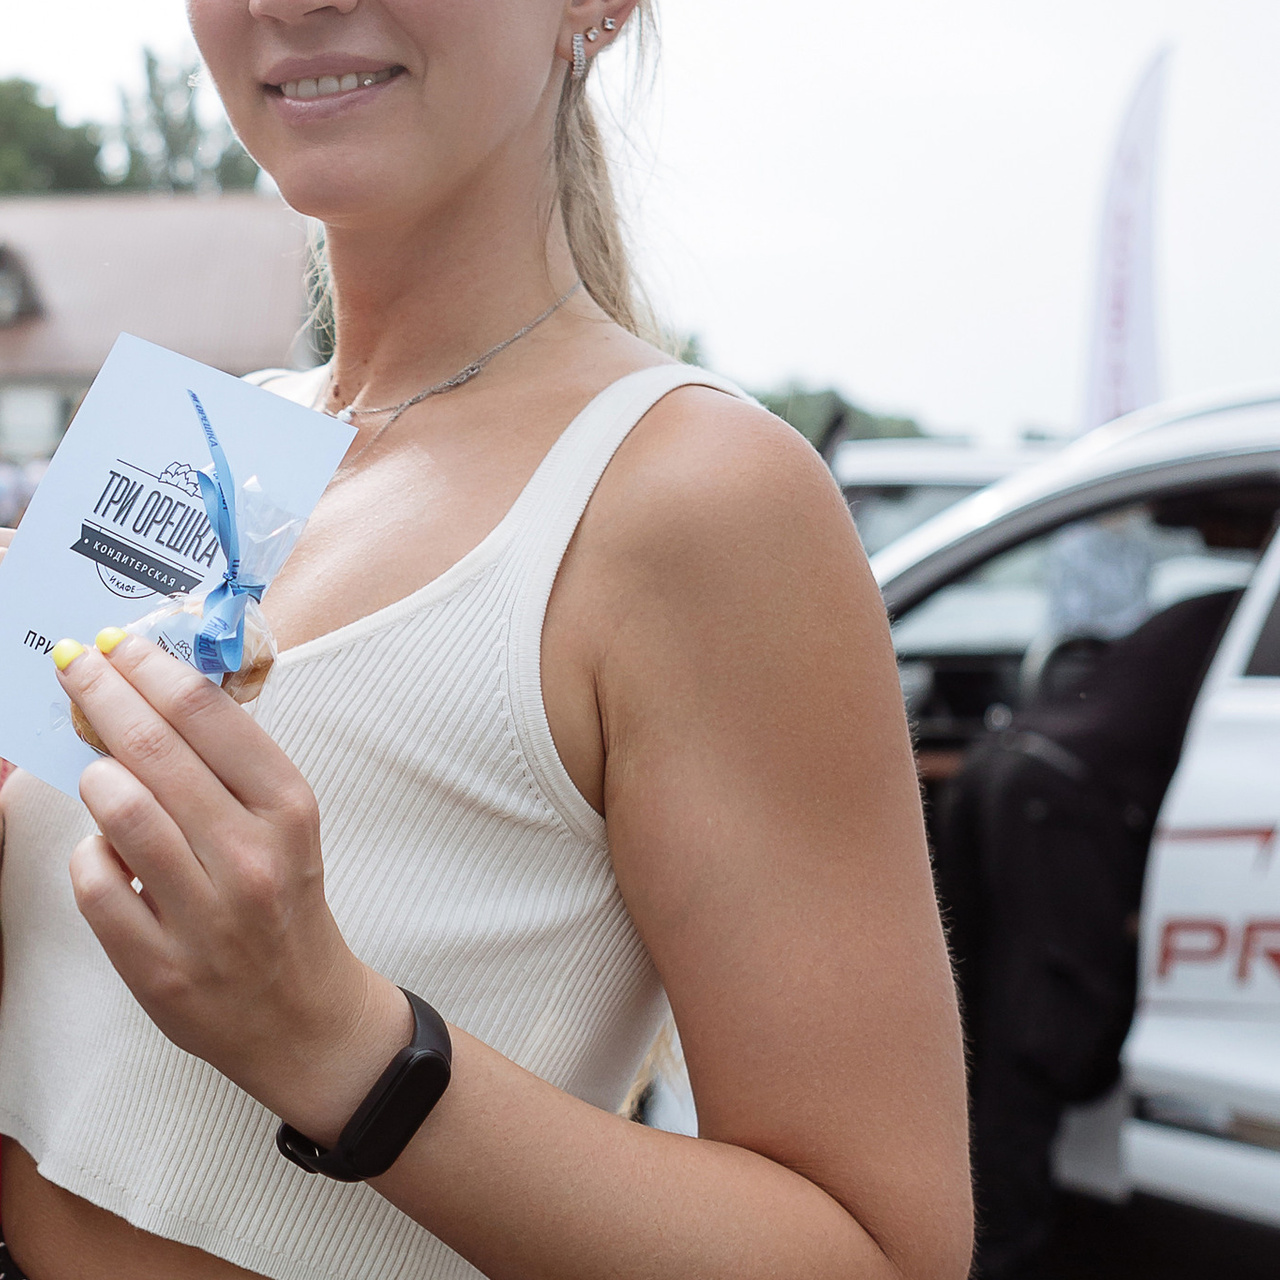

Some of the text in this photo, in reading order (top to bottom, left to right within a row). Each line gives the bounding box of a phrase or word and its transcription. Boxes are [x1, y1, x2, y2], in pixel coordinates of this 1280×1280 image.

[93, 470, 145, 527] ТРИ
[132, 490, 220, 569] ОРЕШКА
[93, 540, 177, 587] КОНДИТЕРСКАЯ
[115, 579, 136, 593] КАФЕ
